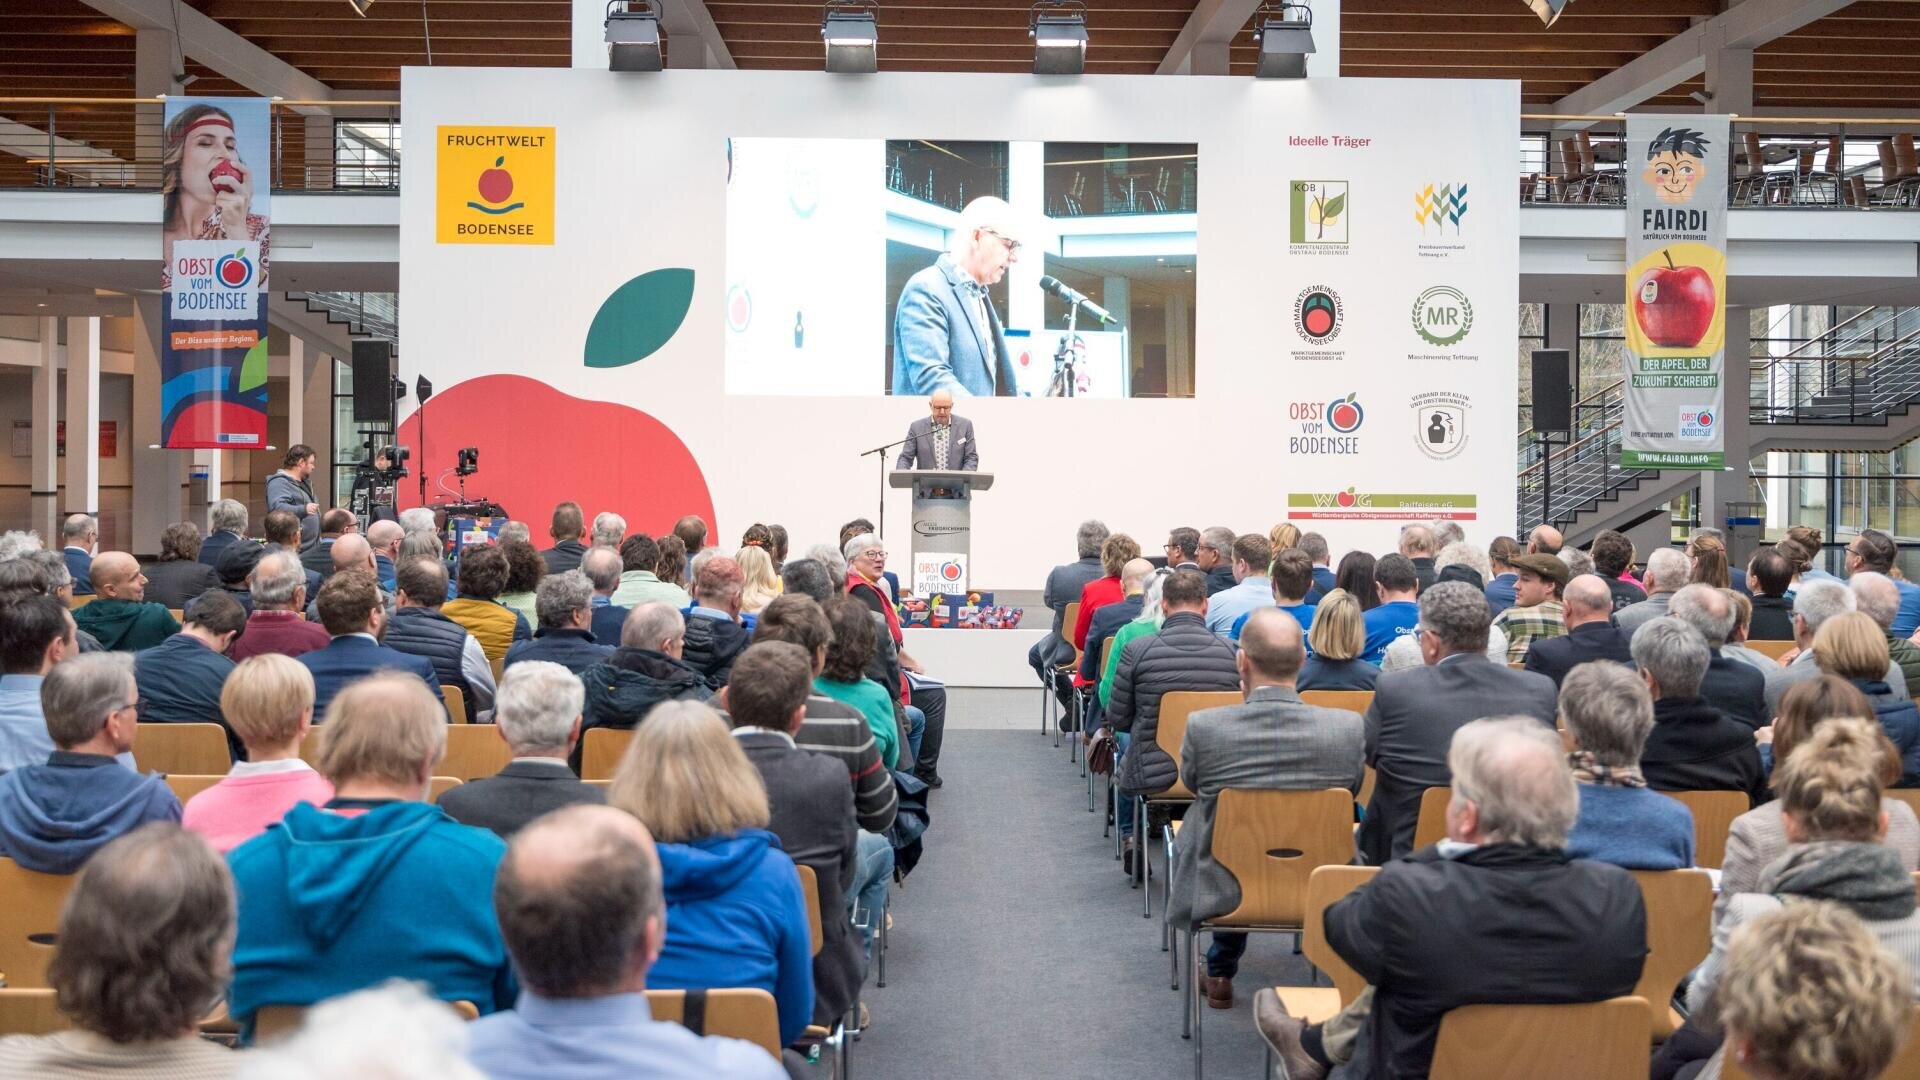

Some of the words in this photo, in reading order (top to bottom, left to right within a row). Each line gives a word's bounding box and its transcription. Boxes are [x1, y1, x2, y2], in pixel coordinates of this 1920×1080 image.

[447, 135, 546, 147] FRUCHTWELT
[1289, 136, 1329, 146] Ideelle
[1332, 136, 1371, 149] Träger
[1294, 184, 1316, 192] KOB
[1643, 208, 1707, 231] FAIRDI
[457, 223, 534, 235] BODENSEE
[178, 258, 215, 275] OBST
[190, 278, 212, 289] VOM
[178, 292, 248, 310] BODENSEE
[1294, 285, 1344, 322] MARKTGEMEINSCHAFT
[1426, 307, 1459, 325] MR
[1294, 321, 1342, 346] BODENSEEOBST
[175, 337, 187, 345] Der
[1643, 359, 1660, 370] DER
[1661, 359, 1690, 371] APFEL,
[1691, 358, 1708, 369] DER
[1634, 375, 1673, 387] ZUKUNFT
[1674, 376, 1717, 387] SCHREIBT!
[1289, 402, 1325, 420] OBST
[1681, 412, 1697, 421] OBST
[1301, 422, 1323, 434] VOM
[1290, 436, 1359, 454] BODENSEE
[1637, 453, 1709, 464] WWW.FAIRDI.INFO
[918, 562, 939, 574] OBST
[926, 574, 939, 582] VOM
[918, 582, 960, 594] BODENSEE
